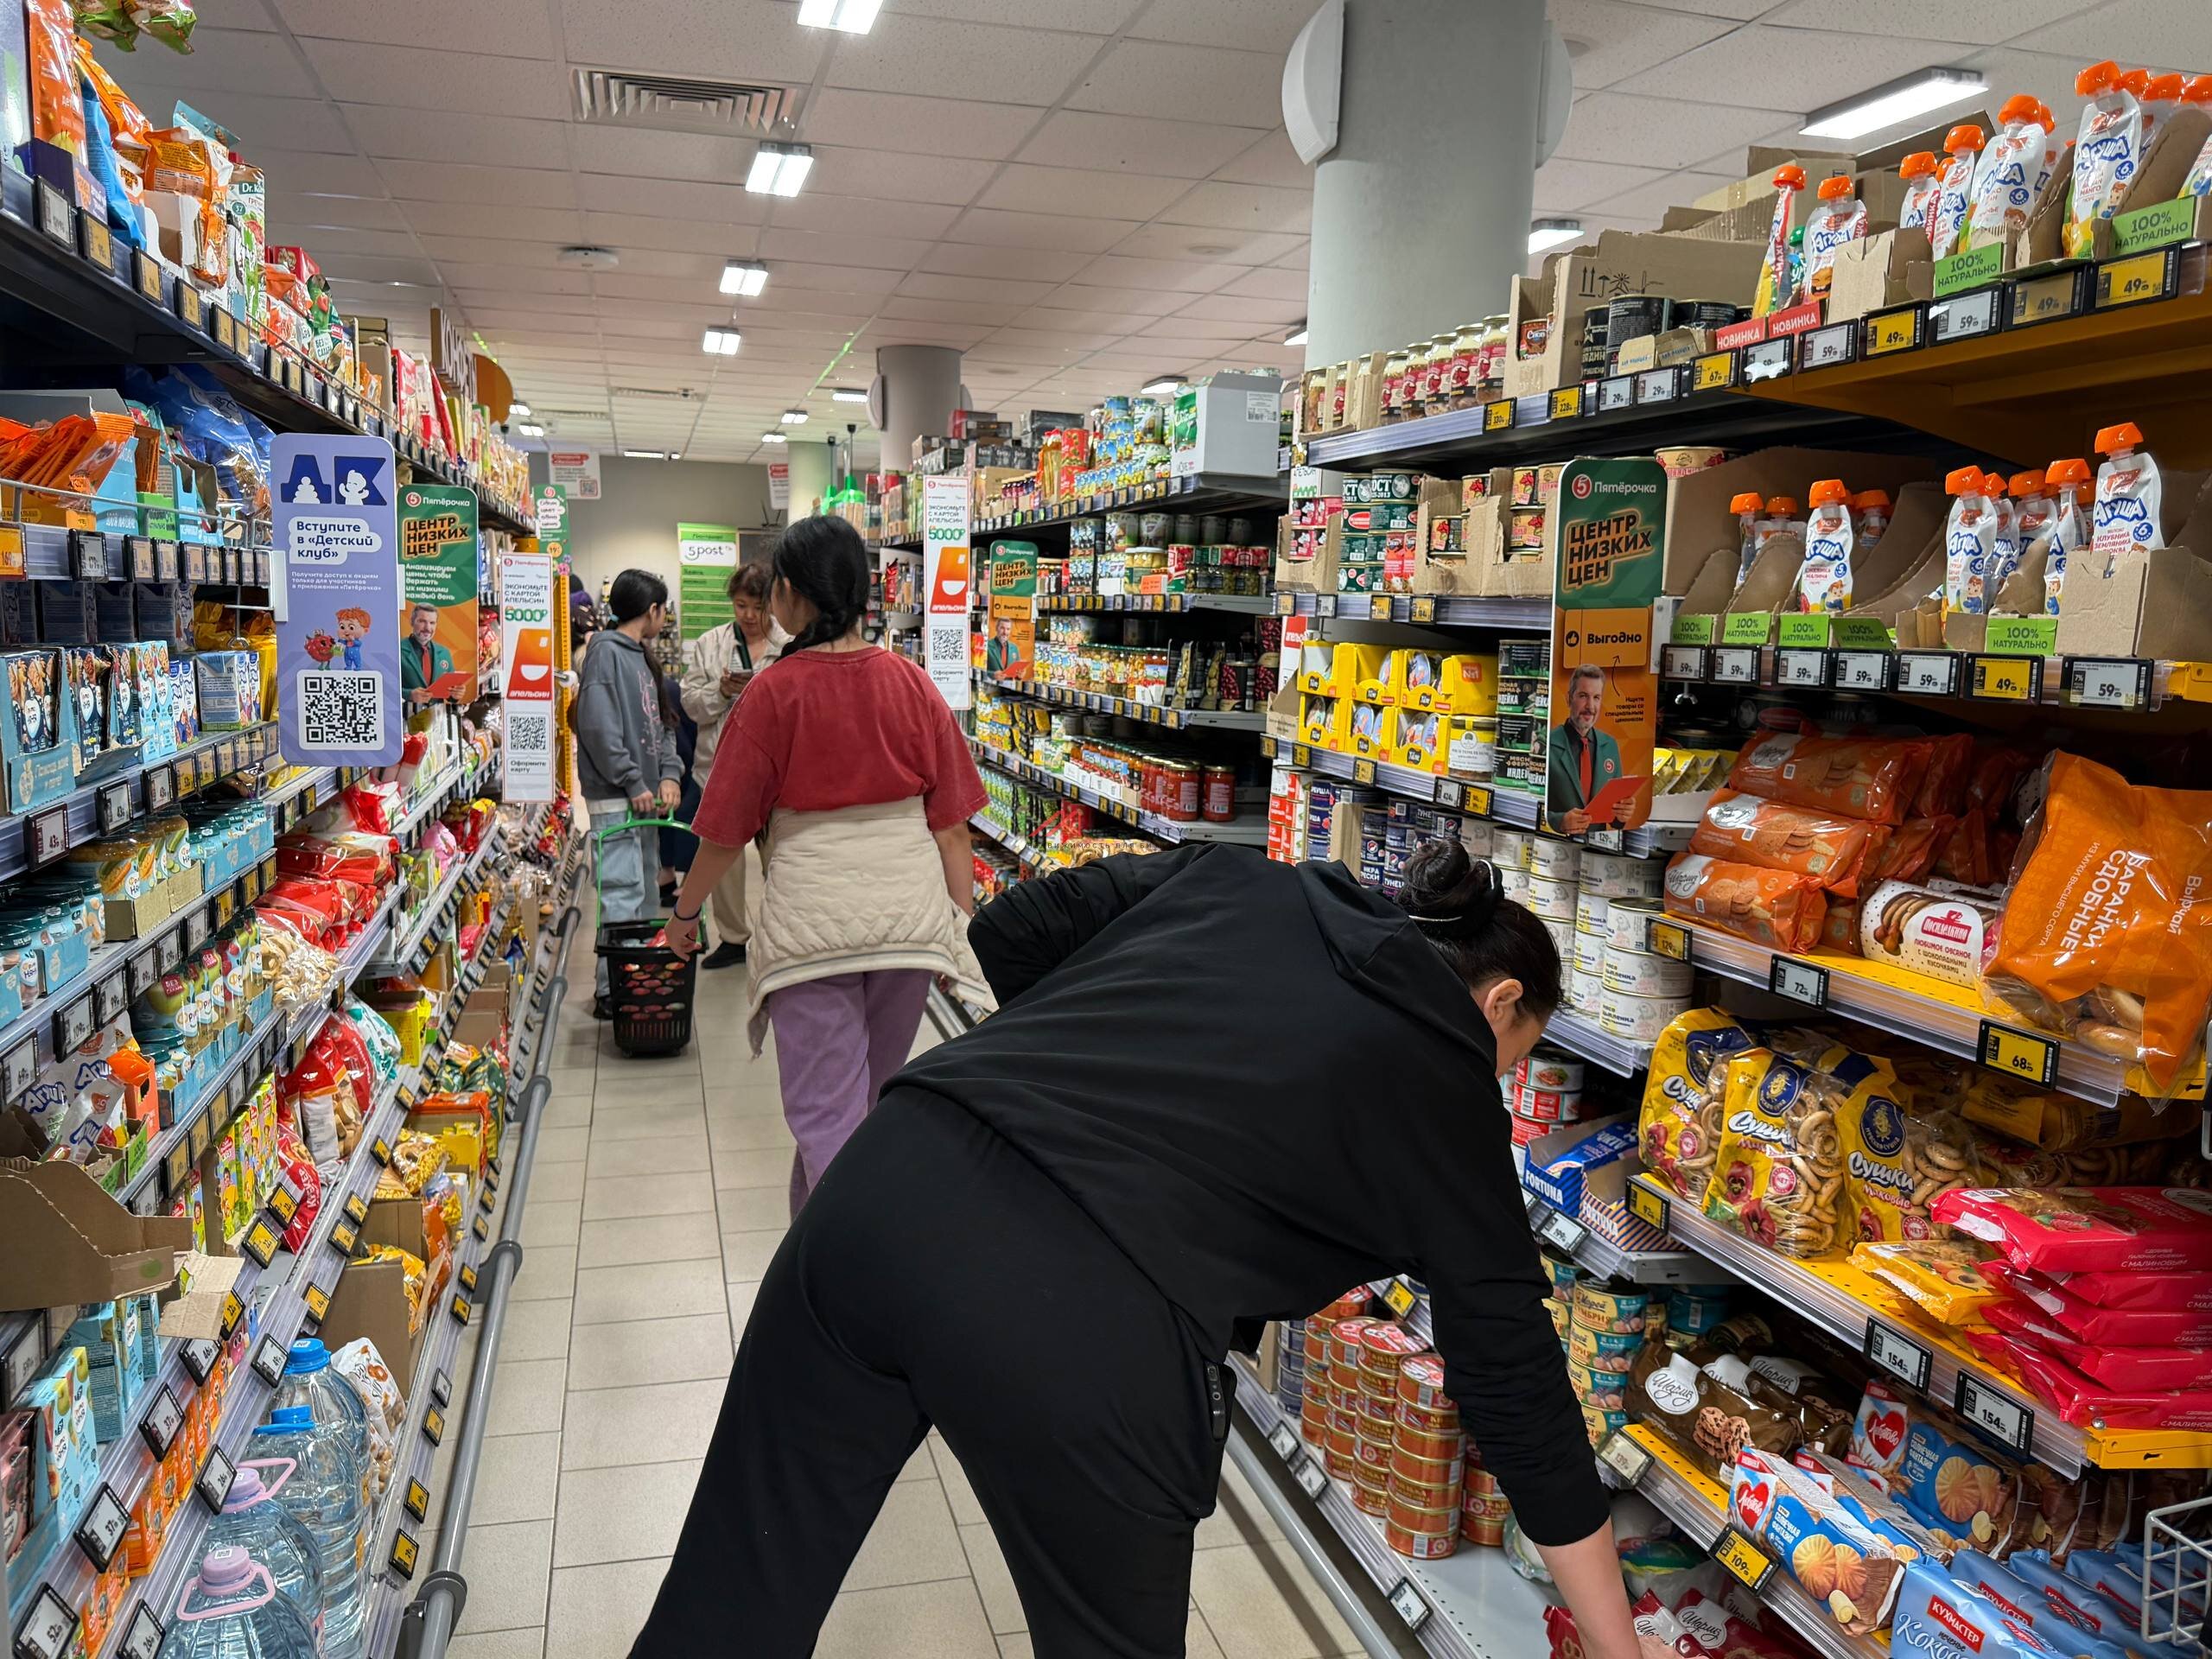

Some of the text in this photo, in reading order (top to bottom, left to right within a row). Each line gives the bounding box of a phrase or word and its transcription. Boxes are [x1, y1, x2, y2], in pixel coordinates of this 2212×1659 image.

[2131, 211, 2172, 234] 100%
[2114, 222, 2188, 250] НАТУРАЛЬНО
[1951, 253, 1984, 272] 100%
[1938, 264, 1998, 287] НАТУРАЛЬНО
[1773, 314, 1816, 334] НОВИНКА
[1717, 327, 1760, 349] НОВИНКА
[1594, 481, 1656, 496] Пятёрочка
[423, 497, 470, 507] Пятёрочка
[296, 521, 361, 533] Вступите
[407, 517, 456, 533] ЦЕНТР
[1570, 514, 1637, 544] ЦЕНТР
[308, 534, 373, 546] «Детский
[406, 526, 469, 543] НИЗКИХ
[2097, 531, 2130, 543] КЛУБНИКА
[297, 548, 339, 560] клуб»
[406, 542, 437, 556] ЦЕН
[1569, 531, 1651, 564] НИЗКИХ
[995, 561, 1025, 572] ЦЕНТР
[995, 568, 1032, 579] НИЗКИХ
[1567, 559, 1609, 586] ЦЕН
[995, 577, 1014, 587] ЦЕН
[1736, 619, 1758, 628] 100%
[1792, 623, 1814, 632] 100%
[1586, 632, 1642, 645] Выгодно
[1726, 629, 1766, 639] НАТУРАЛЬНО
[1782, 633, 1821, 643] НАТУРАЛЬНО
[2006, 627, 2039, 639] 100%
[1993, 639, 2048, 650] НАТУРАЛЬНО
[2098, 683, 2113, 696] 59
[2060, 849, 2126, 950] СДОБНЫЕ
[2039, 919, 2056, 946] СОРТА
[1914, 938, 1942, 951] ЛЮБИМОЕ
[2012, 1055, 2026, 1070] 68
[1847, 1151, 1914, 1193] Сушки
[1526, 1169, 1563, 1205] FORTUNA
[1863, 1184, 1911, 1208] Маковые
[2128, 1259, 2188, 1268] МАЛИНОВЫМ
[1887, 1351, 1904, 1368] 154
[1982, 1409, 2001, 1429] 154
[1732, 1554, 1748, 1571] 109
[1932, 1601, 1980, 1643] КУХМАСТЕР
[1938, 1630, 1966, 1652] печенье
